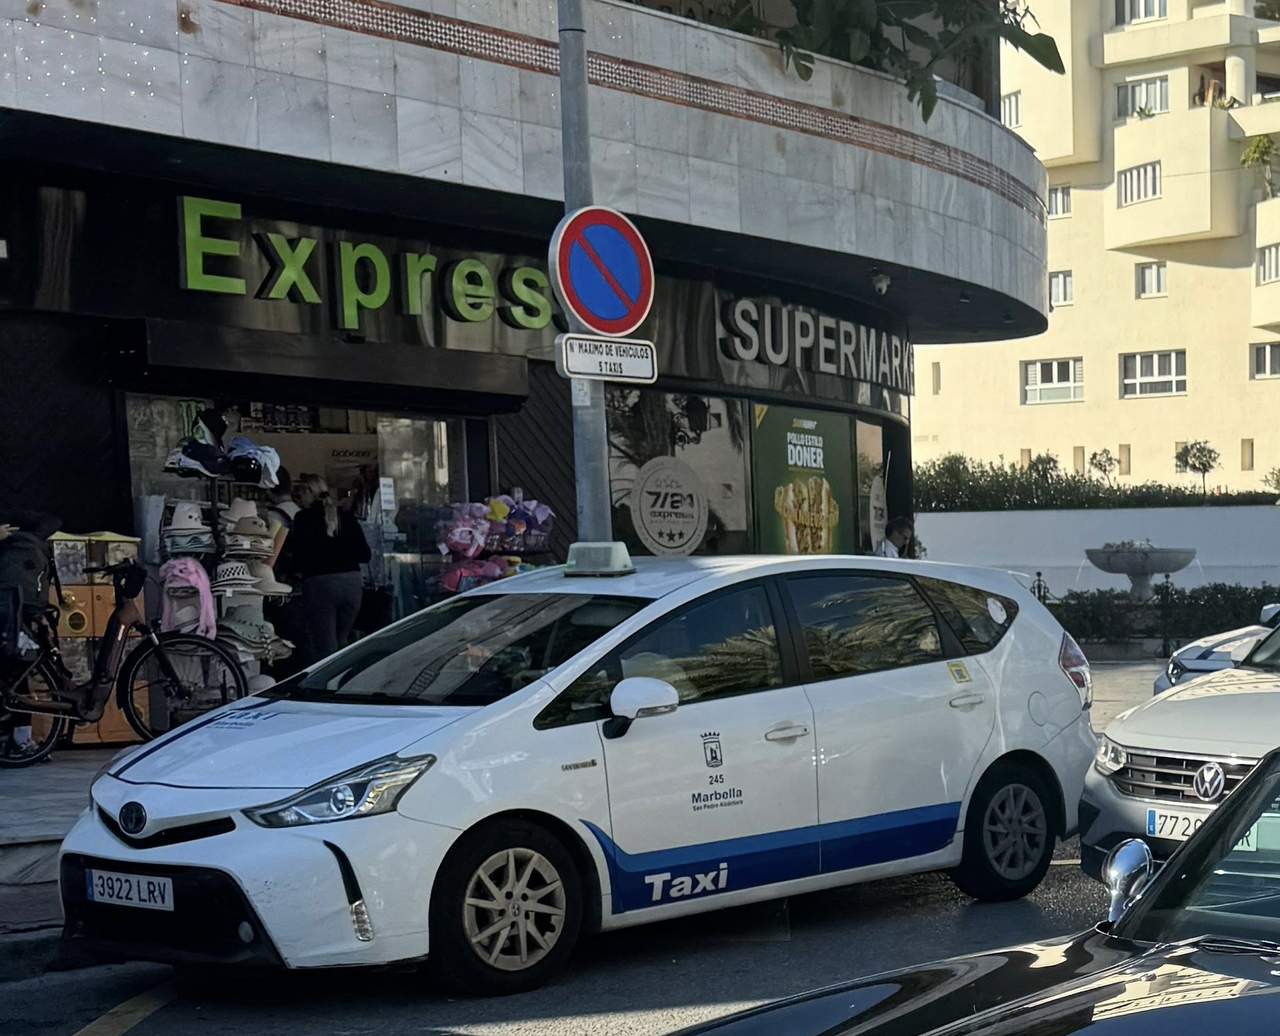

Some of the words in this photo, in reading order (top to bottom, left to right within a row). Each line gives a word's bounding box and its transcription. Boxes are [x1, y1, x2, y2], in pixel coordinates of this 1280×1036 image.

[179, 195, 553, 330] Expres
[605, 344, 613, 357] DE
[598, 361, 603, 372] 5
[604, 361, 623, 374] TAXIS
[787, 444, 824, 469] DONER
[708, 774, 725, 785] 245
[691, 787, 743, 804] Marbella
[97, 875, 133, 901] 3922
[137, 879, 167, 905] LRV
[644, 862, 729, 902] Taxi
